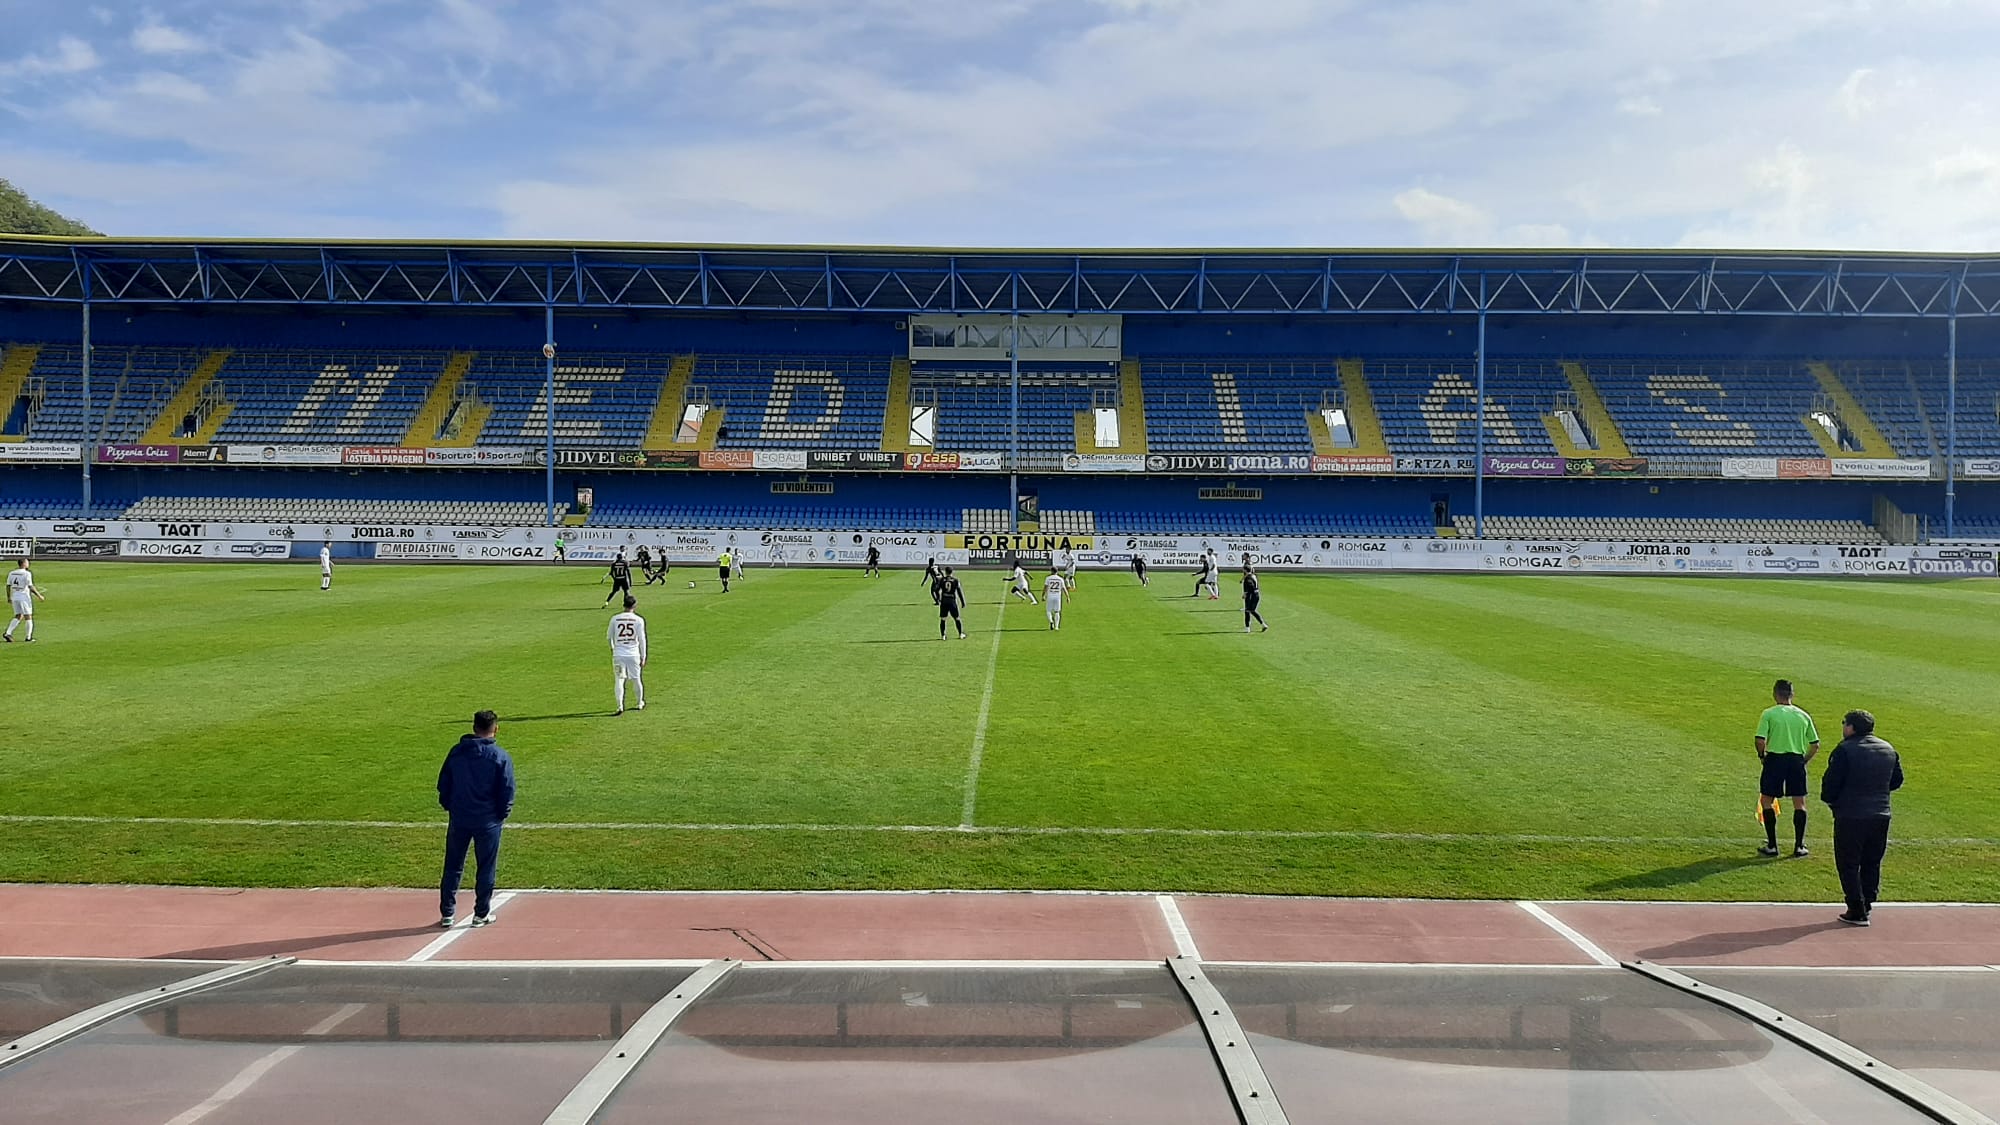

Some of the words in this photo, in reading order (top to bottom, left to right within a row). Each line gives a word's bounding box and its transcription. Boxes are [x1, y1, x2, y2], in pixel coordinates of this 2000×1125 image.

[106, 447, 143, 457] Pizzeria
[755, 452, 804, 462] TEQBALL
[814, 452, 852, 461] UNIBET
[382, 455, 424, 464] PAPAGENO
[558, 451, 614, 464] JIDVEI
[702, 452, 750, 463] TEQBALL
[860, 454, 897, 462] UNIBET
[924, 454, 957, 463] casa
[1169, 456, 1226, 469] JIDVEI
[1350, 464, 1392, 472] PAPAGENO
[1490, 459, 1529, 472] Pizzeria
[1779, 461, 1828, 471] TEQBALL
[772, 482, 784, 492] NU
[786, 482, 827, 492] VIOLENTEI
[1200, 489, 1210, 498] NU
[158, 524, 201, 536] TAQT
[870, 537, 917, 546] ROMGAZ
[140, 544, 202, 554] ROMGAZ
[393, 544, 455, 553] MEDIASTING
[482, 547, 544, 557] ROMGAZ
[1338, 543, 1386, 551] ROMGAZ
[906, 550, 966, 562] ROMGAZ
[969, 550, 1007, 558] UNIBET
[1016, 550, 1052, 559] UNIBET
[1500, 557, 1562, 567] ROMGAZ
[1845, 560, 1908, 571] ROMGAZ
[615, 566, 624, 575] 77
[14, 576, 19, 586] 4
[945, 582, 952, 592] 9
[618, 624, 634, 637] 25
